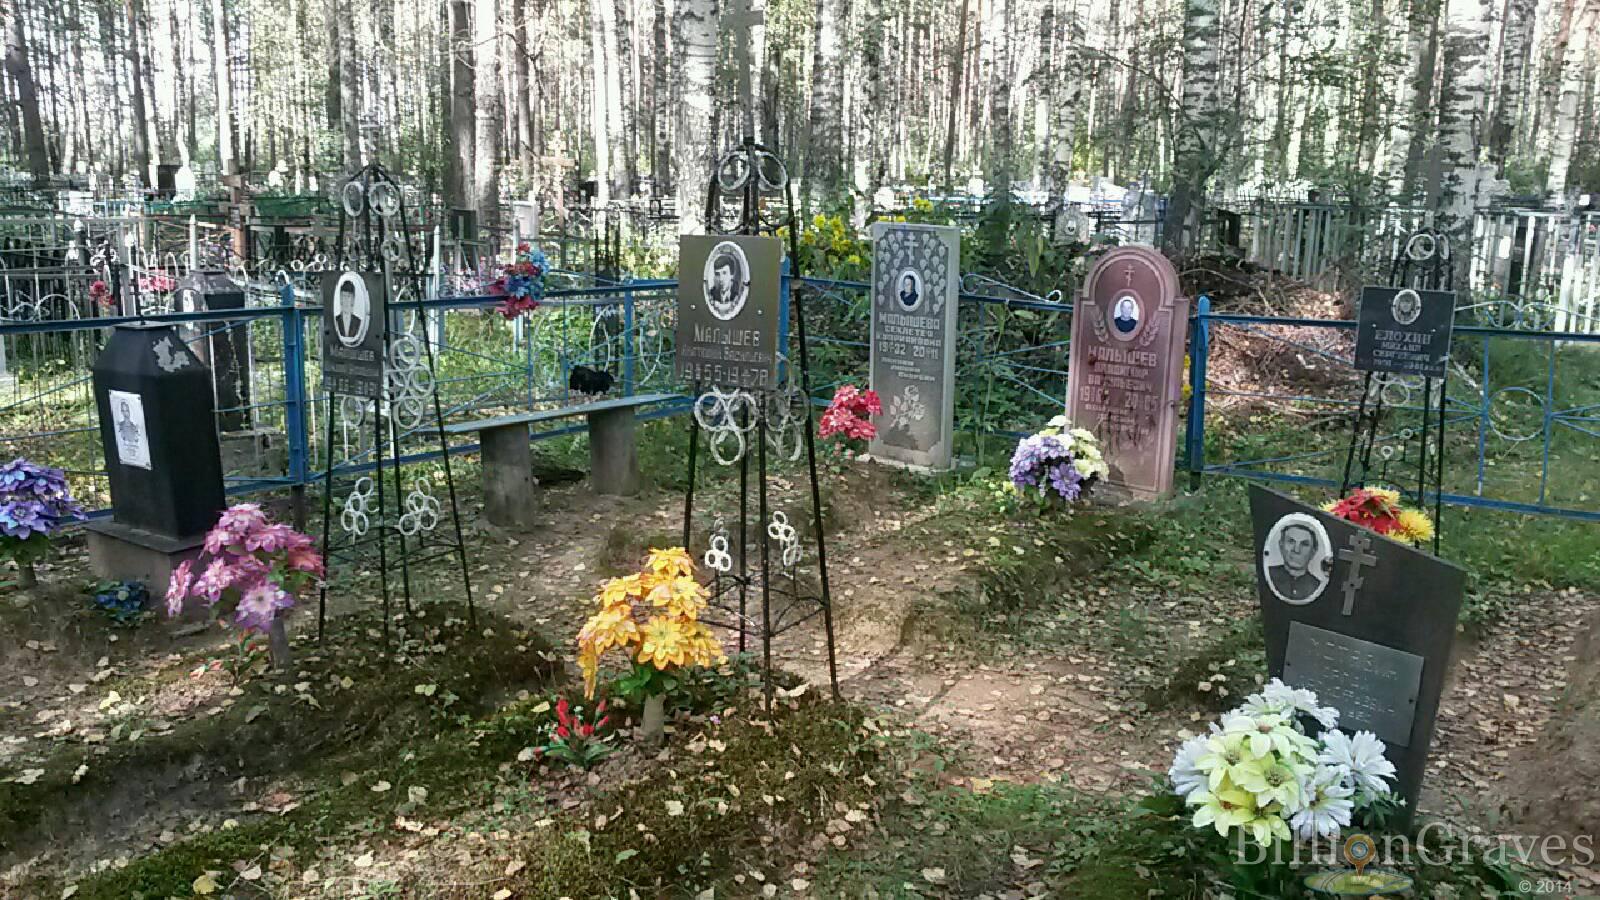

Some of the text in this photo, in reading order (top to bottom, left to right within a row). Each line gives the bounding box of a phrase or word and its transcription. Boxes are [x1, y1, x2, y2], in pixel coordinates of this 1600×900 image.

[879, 311, 940, 330] МАЛЫШЕВА
[694, 324, 760, 346] МАЛЫШЕВ
[1088, 345, 1157, 367] МАЛЫШЕВ
